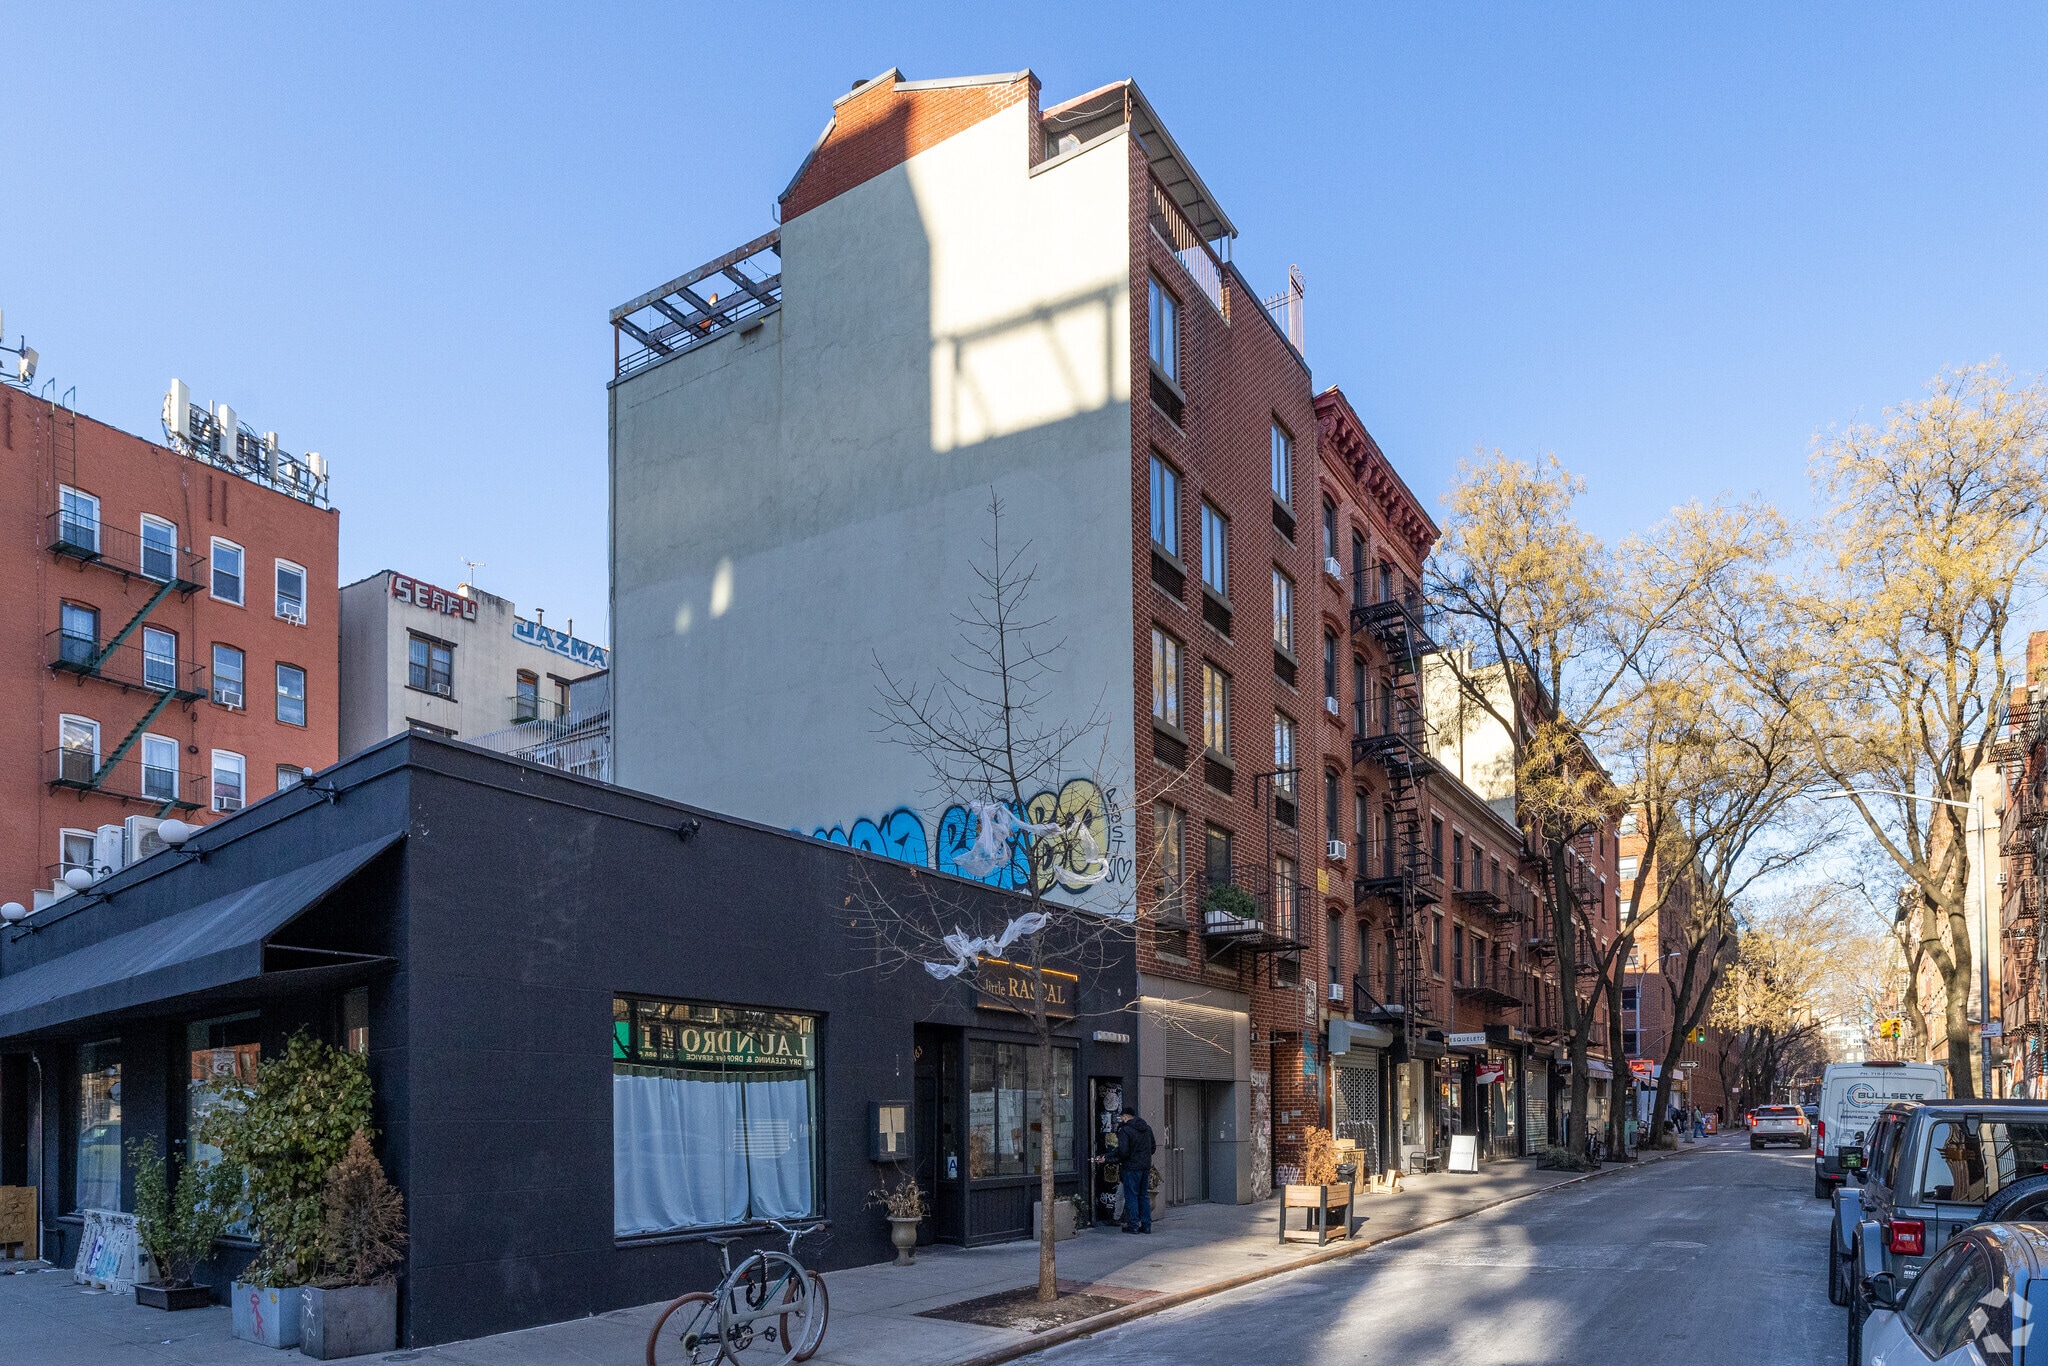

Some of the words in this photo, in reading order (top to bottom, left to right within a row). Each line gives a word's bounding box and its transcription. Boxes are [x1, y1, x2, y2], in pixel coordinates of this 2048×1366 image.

[985, 979, 1006, 996] little
[1858, 1092, 1924, 1100] BULLSEYE
[949, 1159, 957, 1171] A
